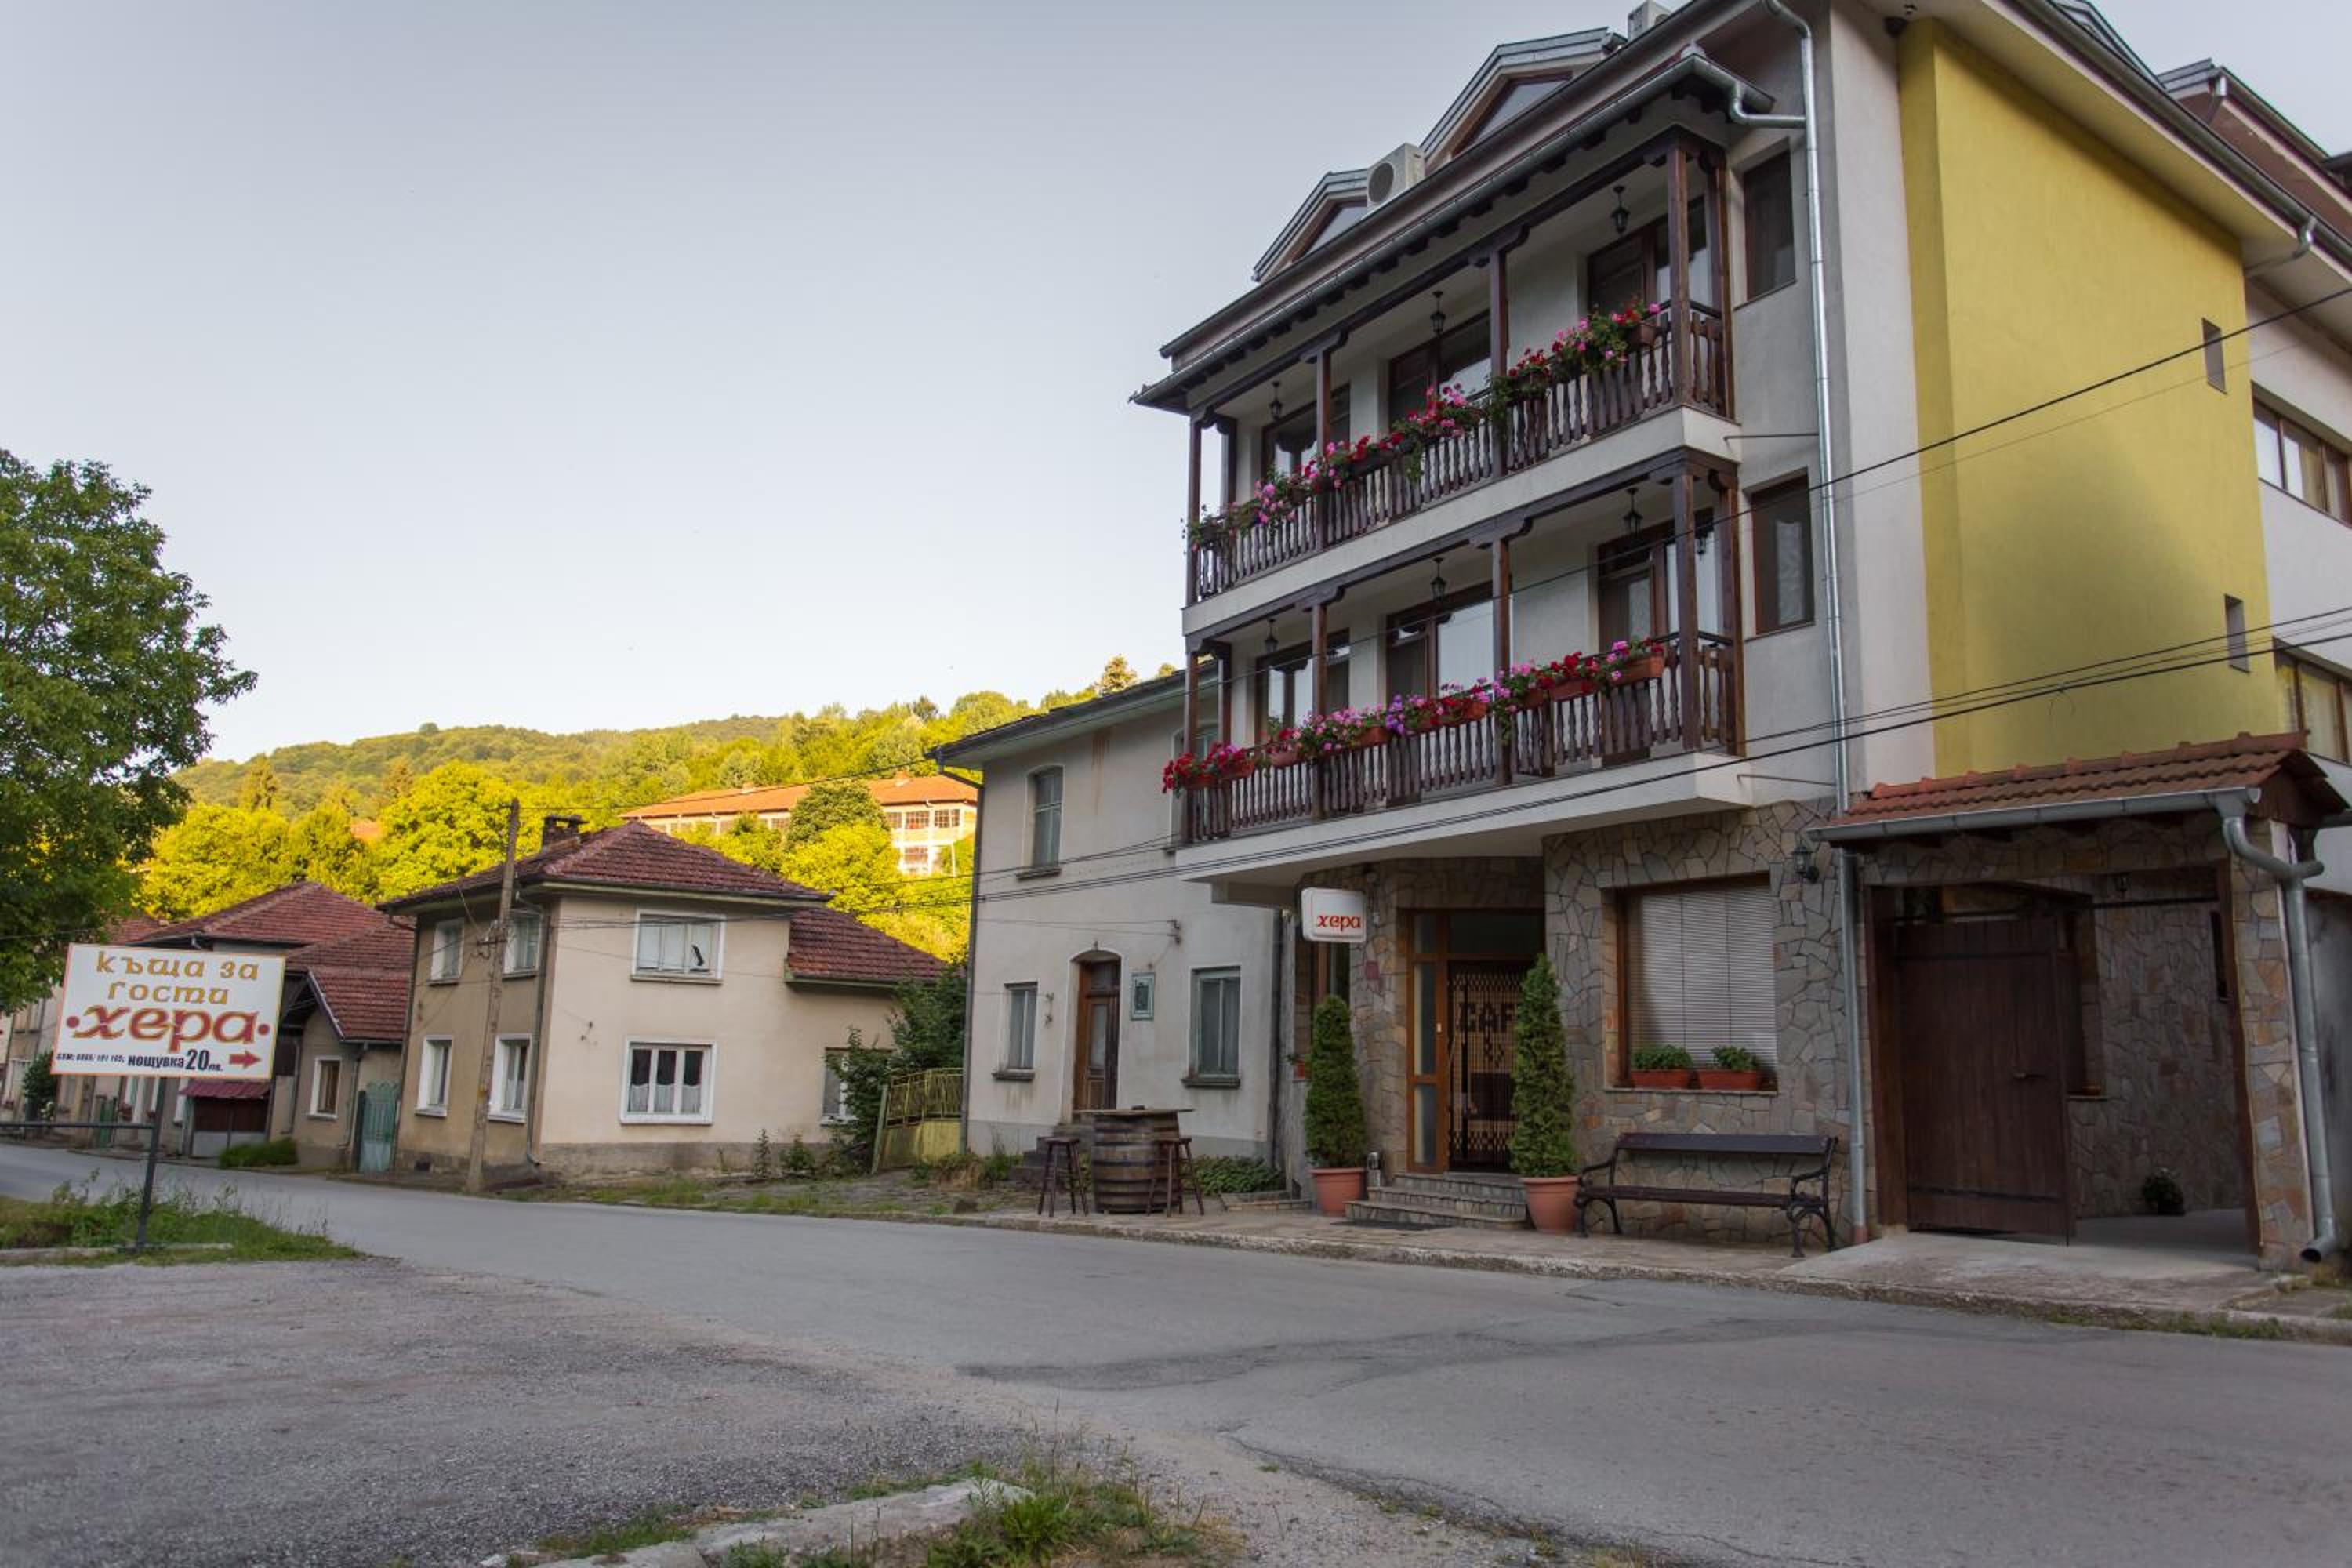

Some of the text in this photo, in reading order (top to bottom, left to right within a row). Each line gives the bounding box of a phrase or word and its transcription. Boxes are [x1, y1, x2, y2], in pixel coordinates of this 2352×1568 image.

[1317, 915, 1361, 932] хера
[96, 950, 260, 980] къща за
[107, 981, 229, 1004] гости
[73, 1004, 260, 1053] хера
[1459, 1002, 1517, 1033] CAF
[128, 1055, 184, 1068] нощувка
